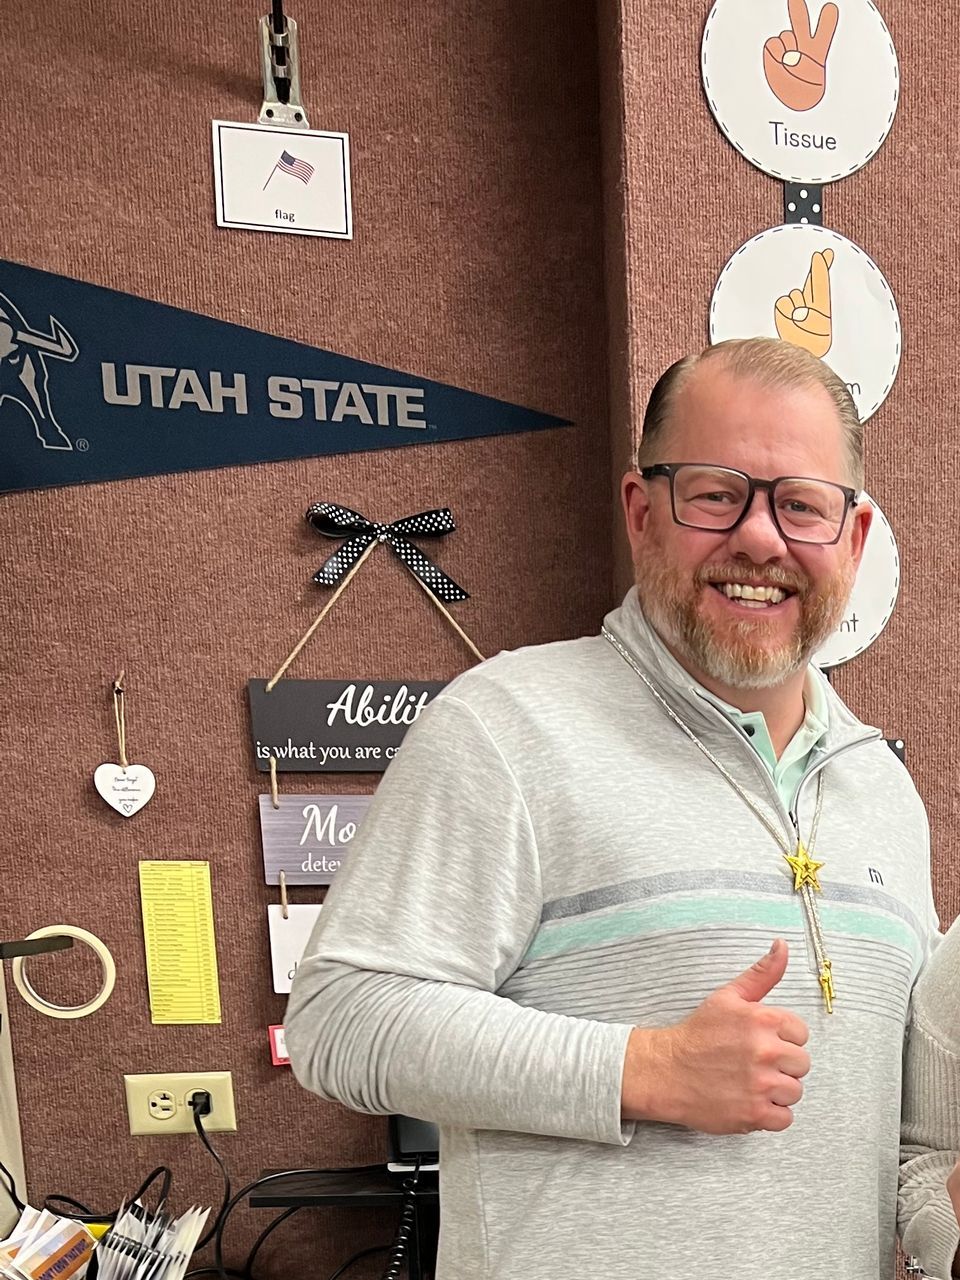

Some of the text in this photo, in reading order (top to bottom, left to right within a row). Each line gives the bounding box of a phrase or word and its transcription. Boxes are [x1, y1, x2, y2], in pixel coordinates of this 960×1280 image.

[767, 120, 837, 152] Tissue
[274, 208, 296, 224] flag
[101, 362, 427, 430] UTAH STATE
[326, 684, 430, 728] Abilit
[256, 738, 402, 770] is what you are ca
[299, 804, 361, 846] Mo
[301, 853, 341, 872] dete
